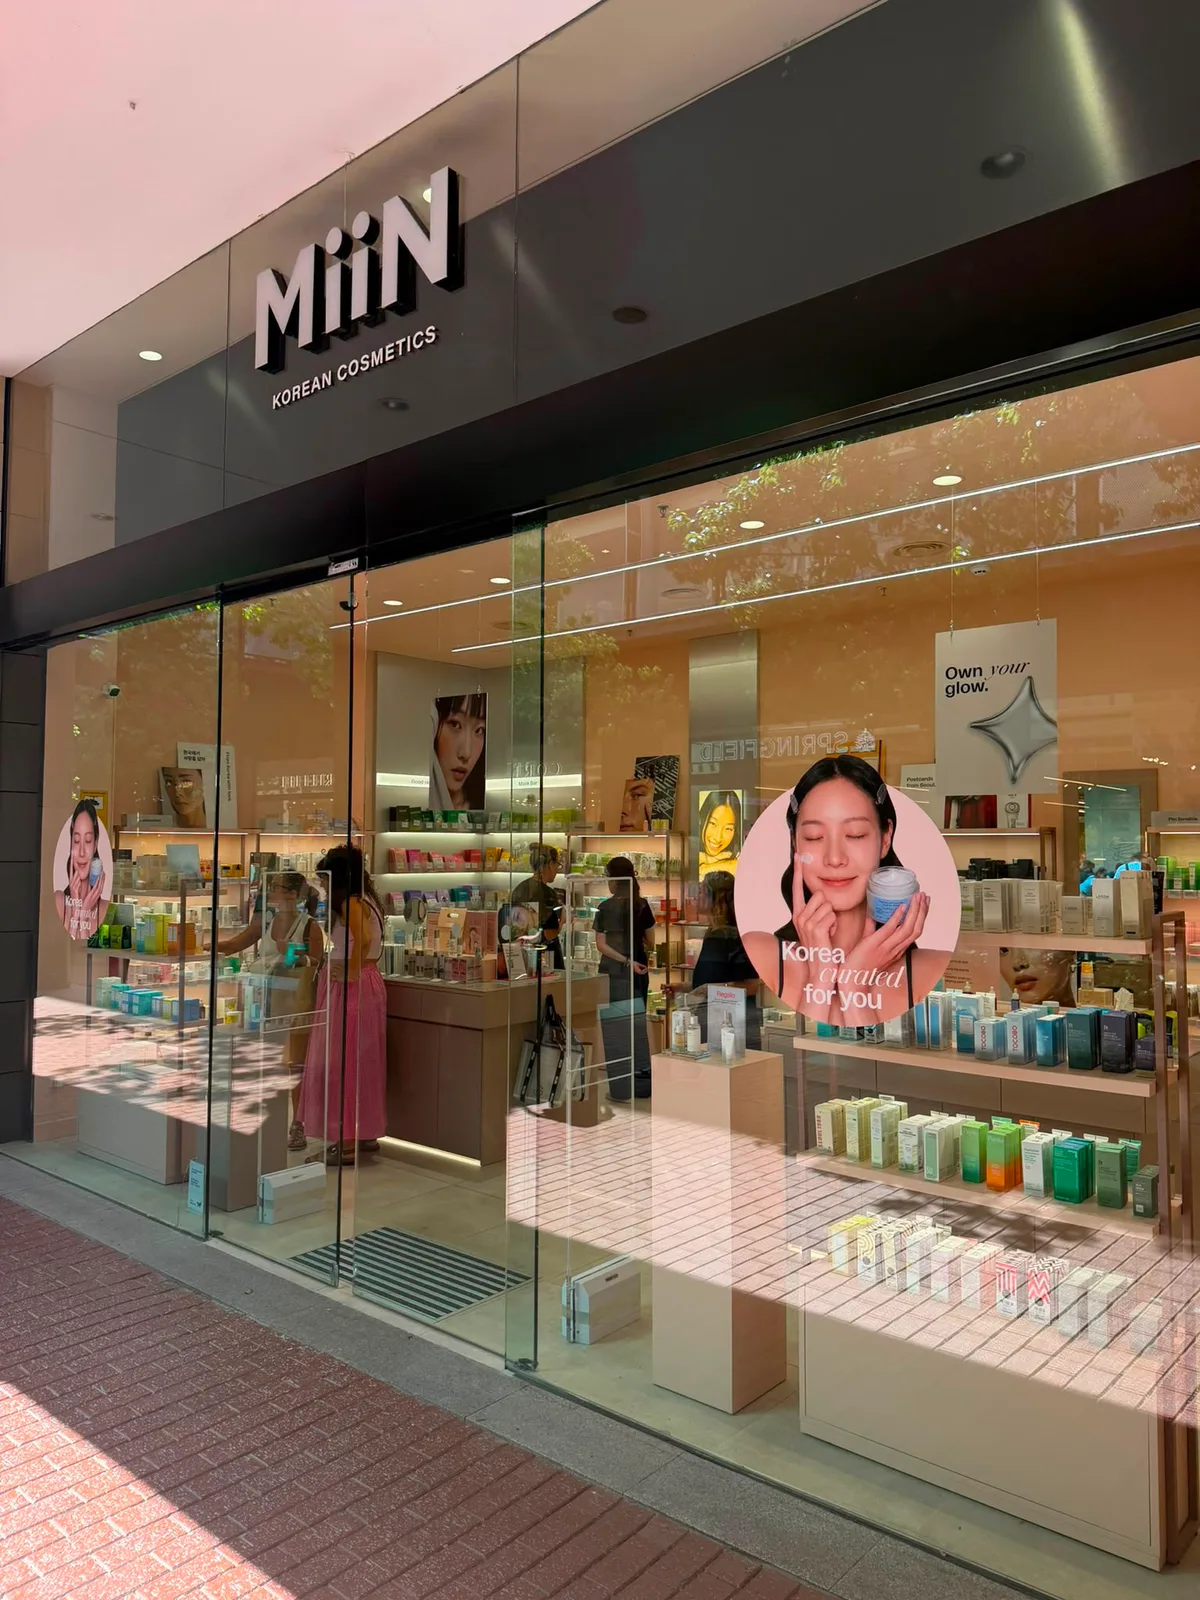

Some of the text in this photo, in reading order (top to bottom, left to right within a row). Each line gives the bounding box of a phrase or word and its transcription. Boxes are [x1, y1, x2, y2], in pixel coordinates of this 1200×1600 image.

[254, 165, 458, 372] MiiN
[271, 325, 438, 410] KOREAN COSMETICS
[945, 661, 1031, 681] Own your
[945, 681, 988, 699] glow.
[65, 895, 83, 907] Korea
[79, 920, 92, 932] you
[781, 940, 846, 963] Korea
[819, 965, 905, 988] curated
[803, 983, 882, 1012] for you
